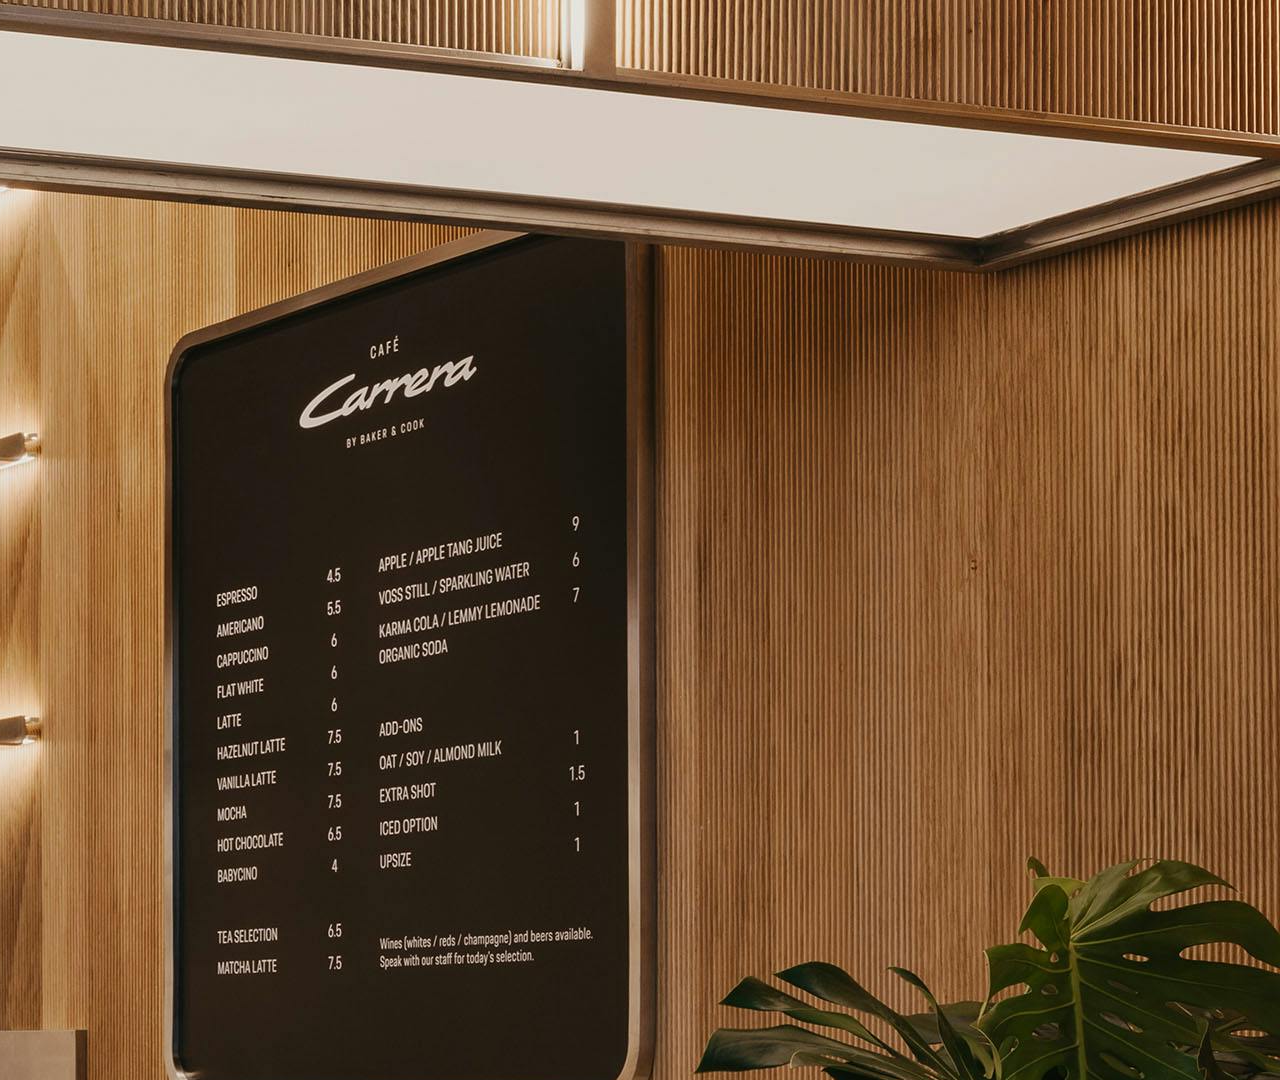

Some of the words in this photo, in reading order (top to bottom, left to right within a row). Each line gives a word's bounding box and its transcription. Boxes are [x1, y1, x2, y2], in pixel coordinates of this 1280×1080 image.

[370, 336, 399, 359] CAFÉ
[299, 355, 477, 429] Carrera
[346, 437, 356, 449] BY
[360, 429, 388, 445] BAKER
[391, 426, 397, 436] &
[400, 418, 425, 434] COOK
[572, 515, 580, 531] 9
[378, 552, 407, 573] APPLE
[408, 552, 414, 566] /
[416, 545, 445, 565] APPLE
[446, 539, 473, 558] TANG
[474, 532, 502, 552] JUICE
[572, 552, 580, 567] 6
[327, 567, 341, 583] 4.5
[378, 587, 403, 605] VOSS
[405, 582, 430, 600] STILL
[432, 580, 438, 595] /
[440, 569, 493, 594] SPARKLING
[494, 562, 530, 582] WATER
[216, 586, 258, 608] ESPRESSO
[572, 587, 580, 603] 7
[327, 600, 341, 616] 5.5
[379, 618, 412, 638] KARMA
[414, 614, 439, 632] COLA
[440, 612, 446, 627] /
[448, 605, 483, 626] LEMMY
[485, 594, 540, 620] LEMONADE
[217, 616, 264, 638] AMERICANO
[331, 633, 338, 648] 6
[217, 646, 269, 668] CAPPUCCINO
[379, 644, 420, 664] ORGANIC
[422, 638, 448, 657] SODA
[331, 665, 338, 680] 6
[217, 683, 236, 699] FLAT
[237, 678, 264, 696] WHITE
[331, 698, 338, 712] 6
[217, 713, 241, 730] LATTE
[379, 717, 423, 737] ADD-ONS
[328, 729, 341, 744] 7.5
[573, 730, 579, 744] 1
[217, 741, 259, 760] HAZELNUT
[260, 737, 286, 755] LATTE
[379, 754, 397, 770] OAT
[399, 753, 404, 767] /
[406, 750, 425, 767] SOY
[426, 749, 432, 764] /
[433, 743, 475, 763] ALMOND
[477, 740, 502, 758] MILK
[328, 762, 341, 777] 7.5
[569, 764, 585, 781] 1.5
[217, 774, 250, 791] VANILLA
[252, 770, 276, 786] LATTE
[379, 786, 409, 803] EXTRA
[410, 782, 436, 800] SHOT
[328, 794, 342, 809] 7.5
[574, 801, 579, 816] 1
[217, 805, 247, 822] MOCHA
[328, 826, 342, 841] 6.5
[379, 820, 400, 836] ICED
[403, 816, 438, 834] OPTION
[217, 837, 234, 852] HOT
[235, 832, 283, 851] CHOCOLATE
[574, 837, 580, 852] 1
[331, 858, 338, 873] 4
[379, 852, 412, 869] UPSIZE
[217, 866, 257, 883] BABYCINO
[217, 930, 233, 944] TEA
[234, 928, 278, 943] SELECTION
[328, 923, 342, 938] 6.5
[380, 936, 402, 950] Wines
[404, 935, 432, 951] (whites
[433, 935, 438, 947] /
[439, 934, 456, 947] reds
[457, 934, 462, 946] /
[463, 930, 512, 948] champagne)
[514, 930, 529, 944] and
[530, 929, 553, 943] beers
[554, 927, 593, 942] available.
[217, 960, 251, 975] MATCHA
[252, 959, 277, 974] LATTE
[328, 956, 342, 970] 7.5
[380, 954, 402, 970] Speak
[404, 954, 420, 967] with
[421, 956, 433, 966] our
[435, 952, 453, 965] staff
[454, 952, 465, 964] for
[466, 950, 494, 966] today's
[496, 949, 534, 963] selection.
